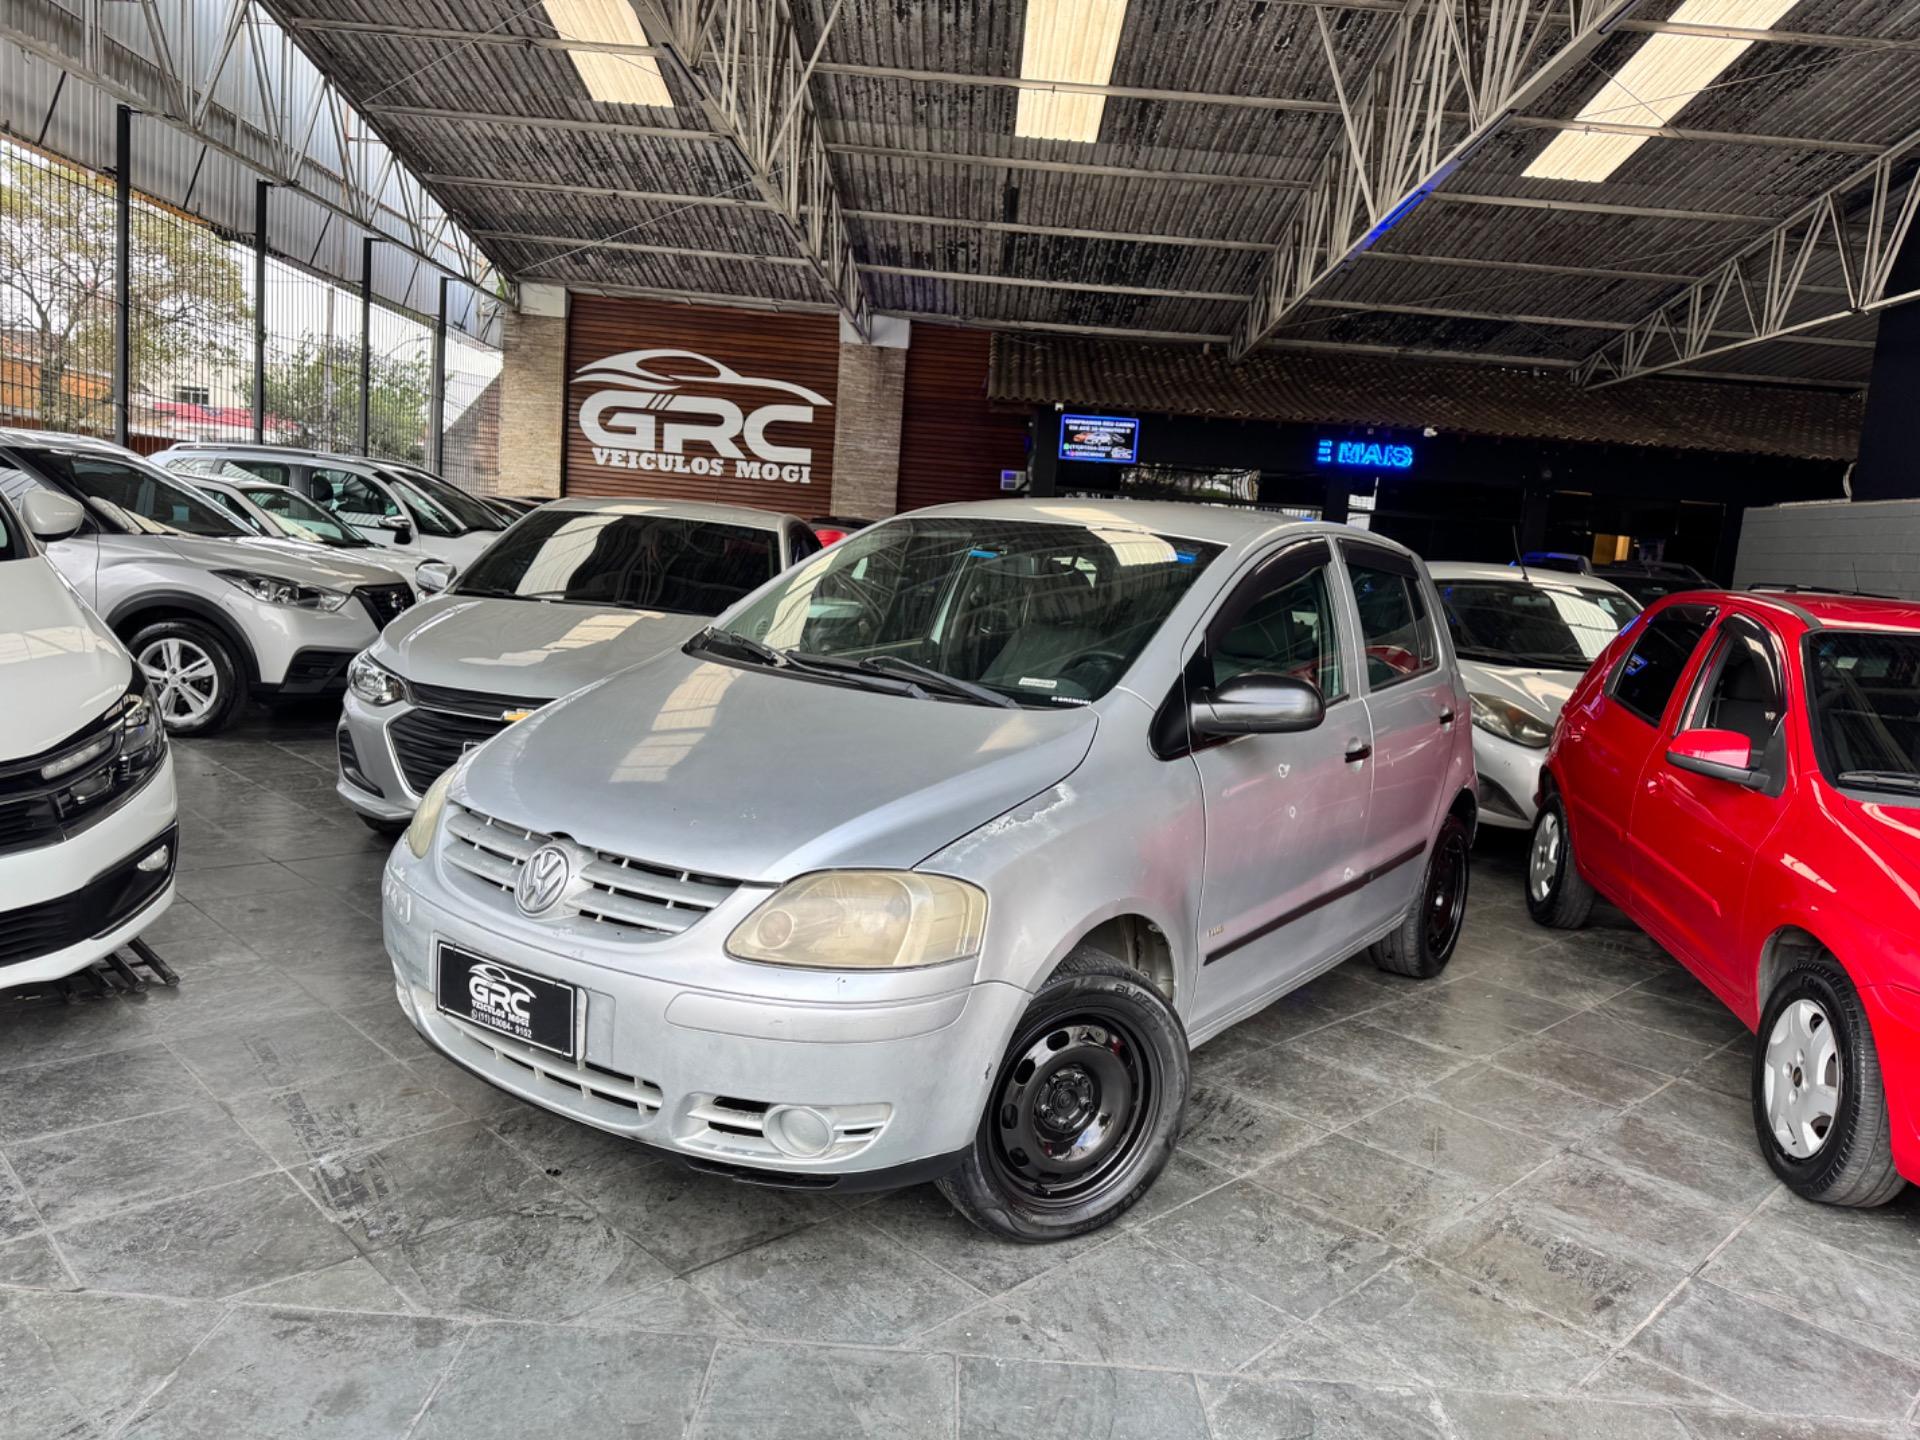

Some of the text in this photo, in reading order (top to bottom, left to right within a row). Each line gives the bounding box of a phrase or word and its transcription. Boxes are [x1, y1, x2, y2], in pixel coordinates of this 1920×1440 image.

[579, 390, 814, 465] GRC
[592, 447, 812, 484] VEICULOS MOGI
[1338, 442, 1413, 467] MAIS
[469, 975, 531, 1019] GRC
[471, 998, 530, 1029] VEICULOS MOGI
